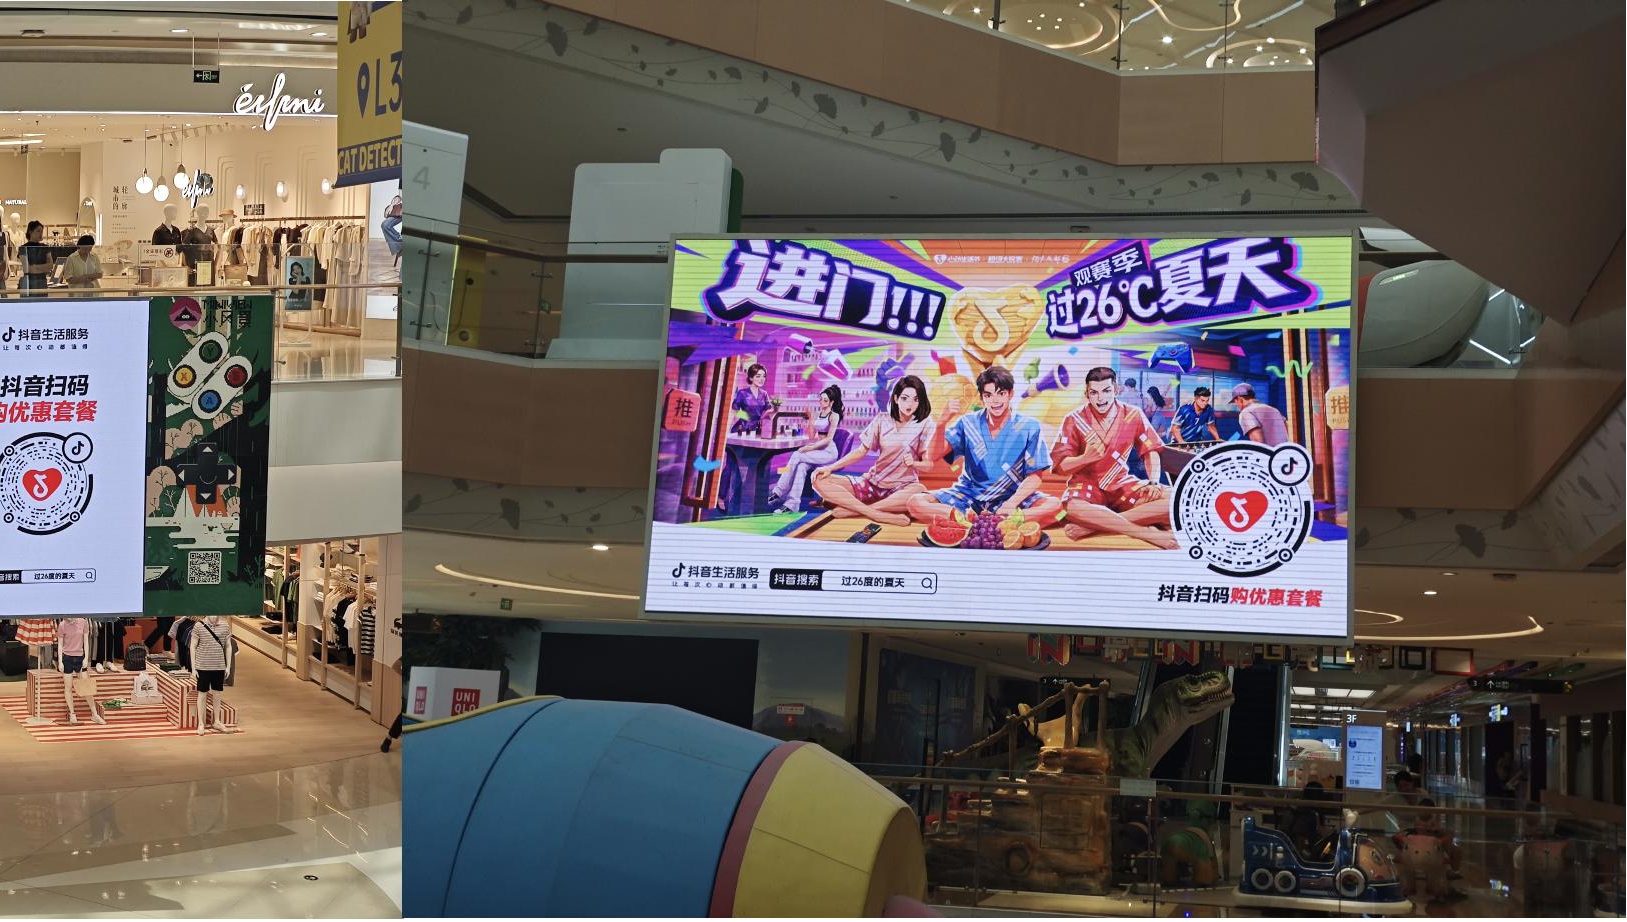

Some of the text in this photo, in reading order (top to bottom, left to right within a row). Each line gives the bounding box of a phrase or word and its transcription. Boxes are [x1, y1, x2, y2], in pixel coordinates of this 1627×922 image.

[412, 166, 431, 190] 4
[1074, 248, 1143, 287] 观赛季
[18, 328, 89, 341] 抖音生活服务
[0, 374, 89, 397] 抖音扫码
[675, 398, 694, 418] 推
[1331, 395, 1349, 414] 推
[34, 571, 76, 581] 过26度的夏天
[688, 565, 760, 579] 抖音生活服务
[774, 573, 905, 589] 抖音搜索 过26度的夏天
[455, 690, 477, 703] UNI
[1346, 714, 1357, 723] 3F
